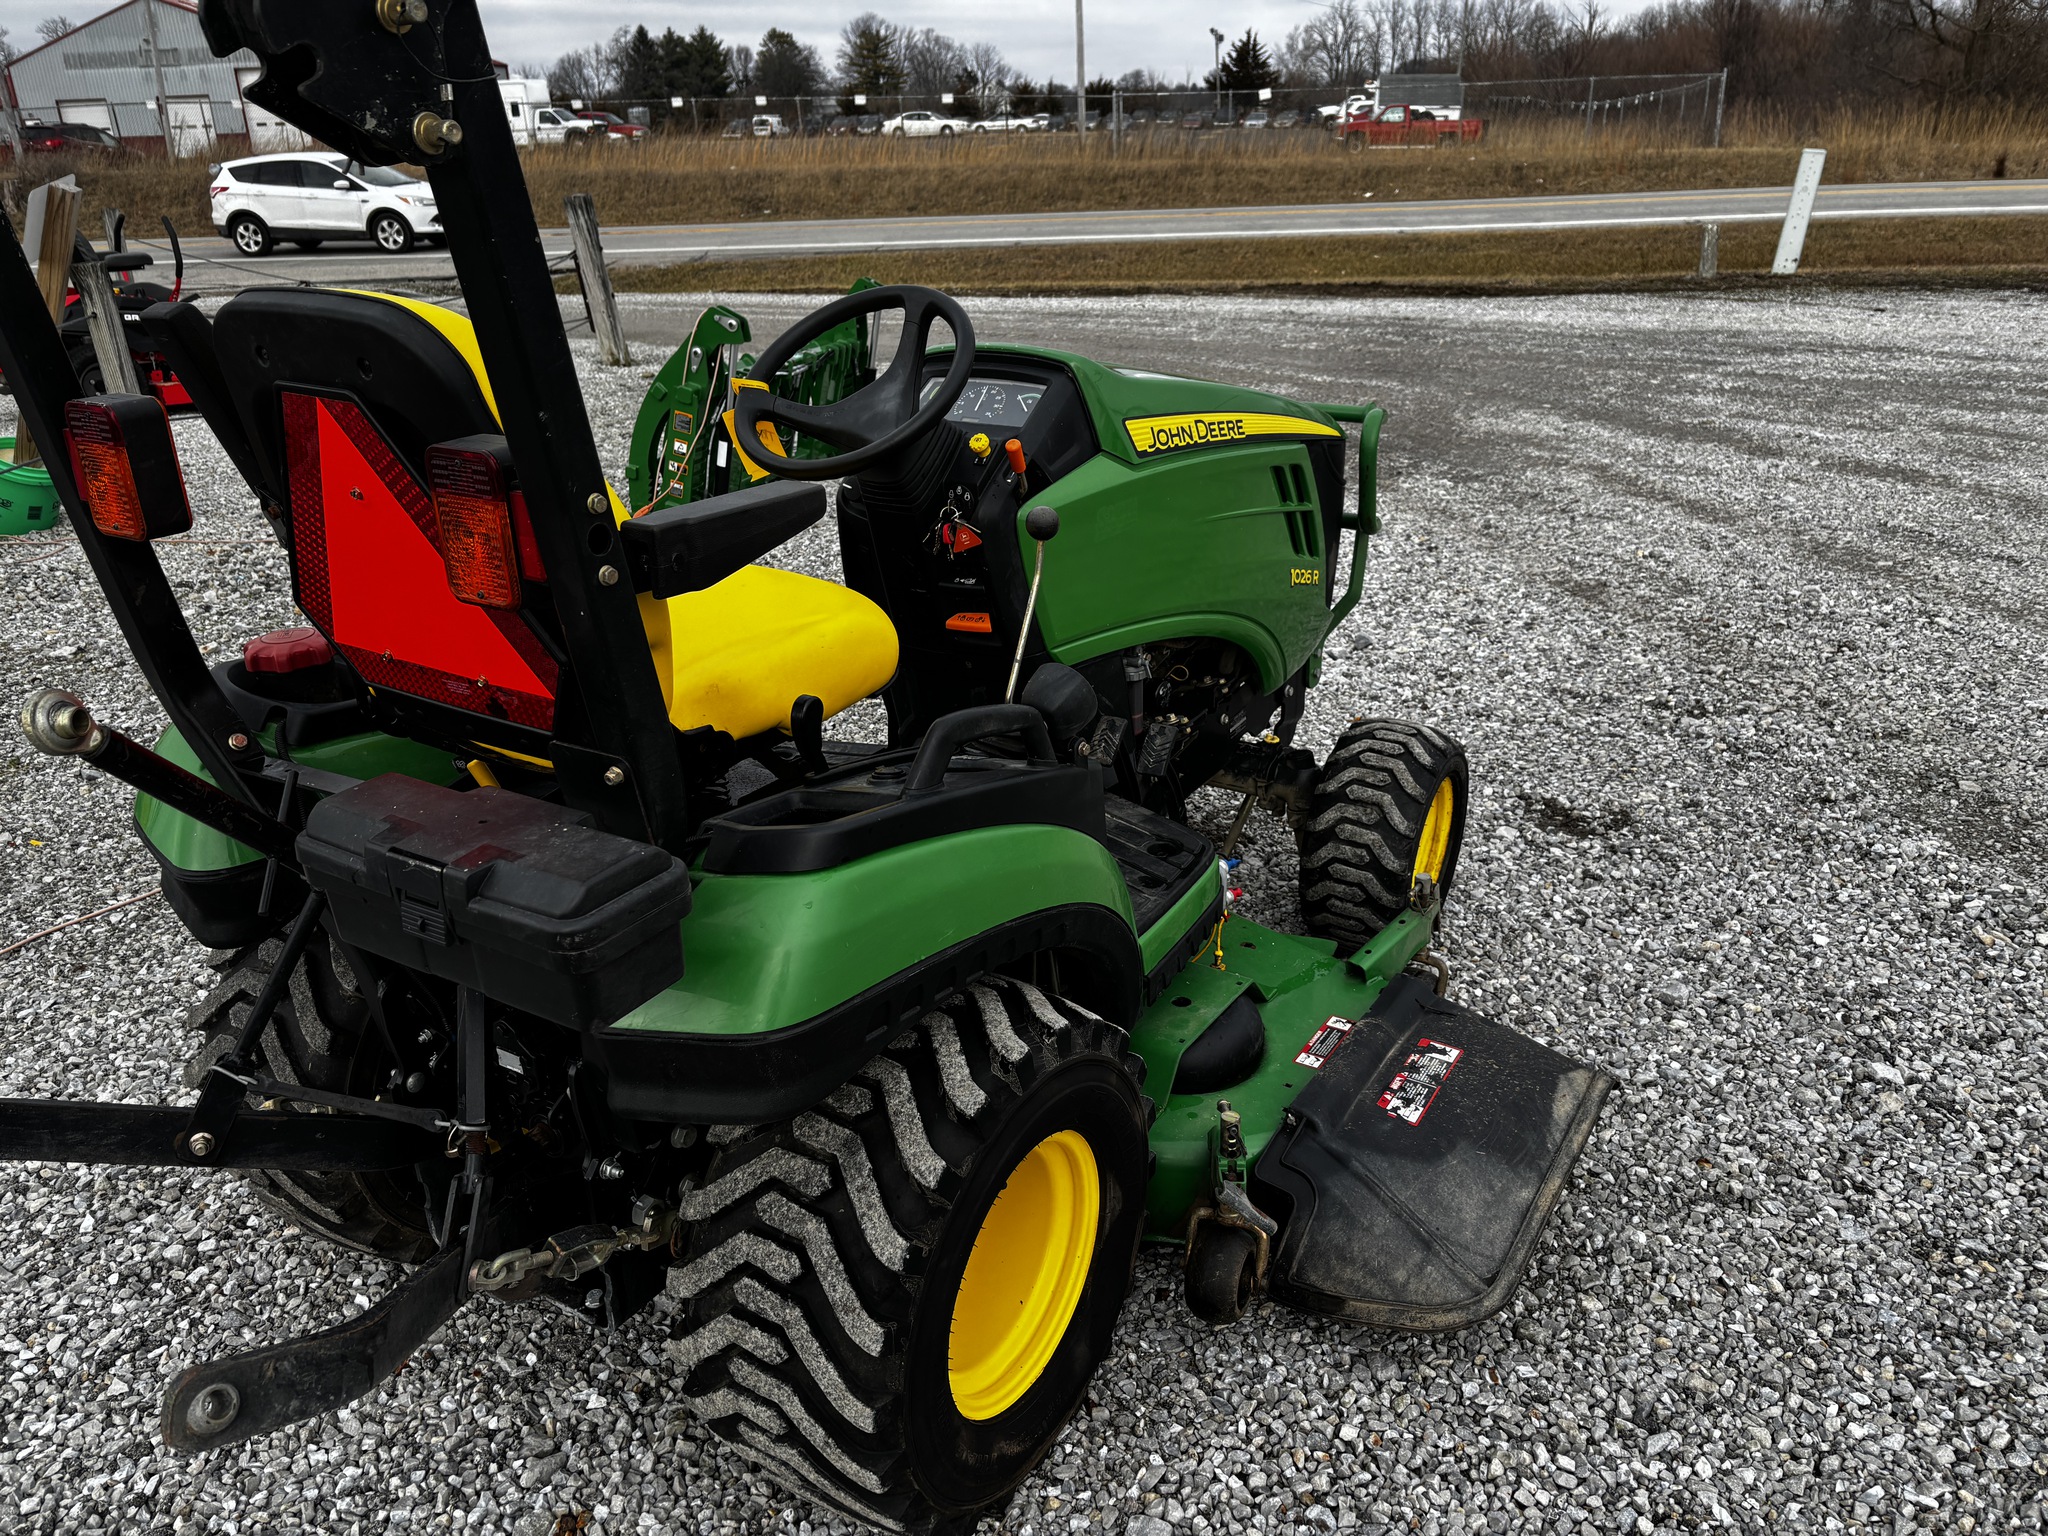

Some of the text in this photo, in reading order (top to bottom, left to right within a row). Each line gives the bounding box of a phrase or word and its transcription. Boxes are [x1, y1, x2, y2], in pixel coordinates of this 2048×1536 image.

[1147, 419, 1246, 450] JOHN DEERE
[1290, 568, 1312, 587] 1026
